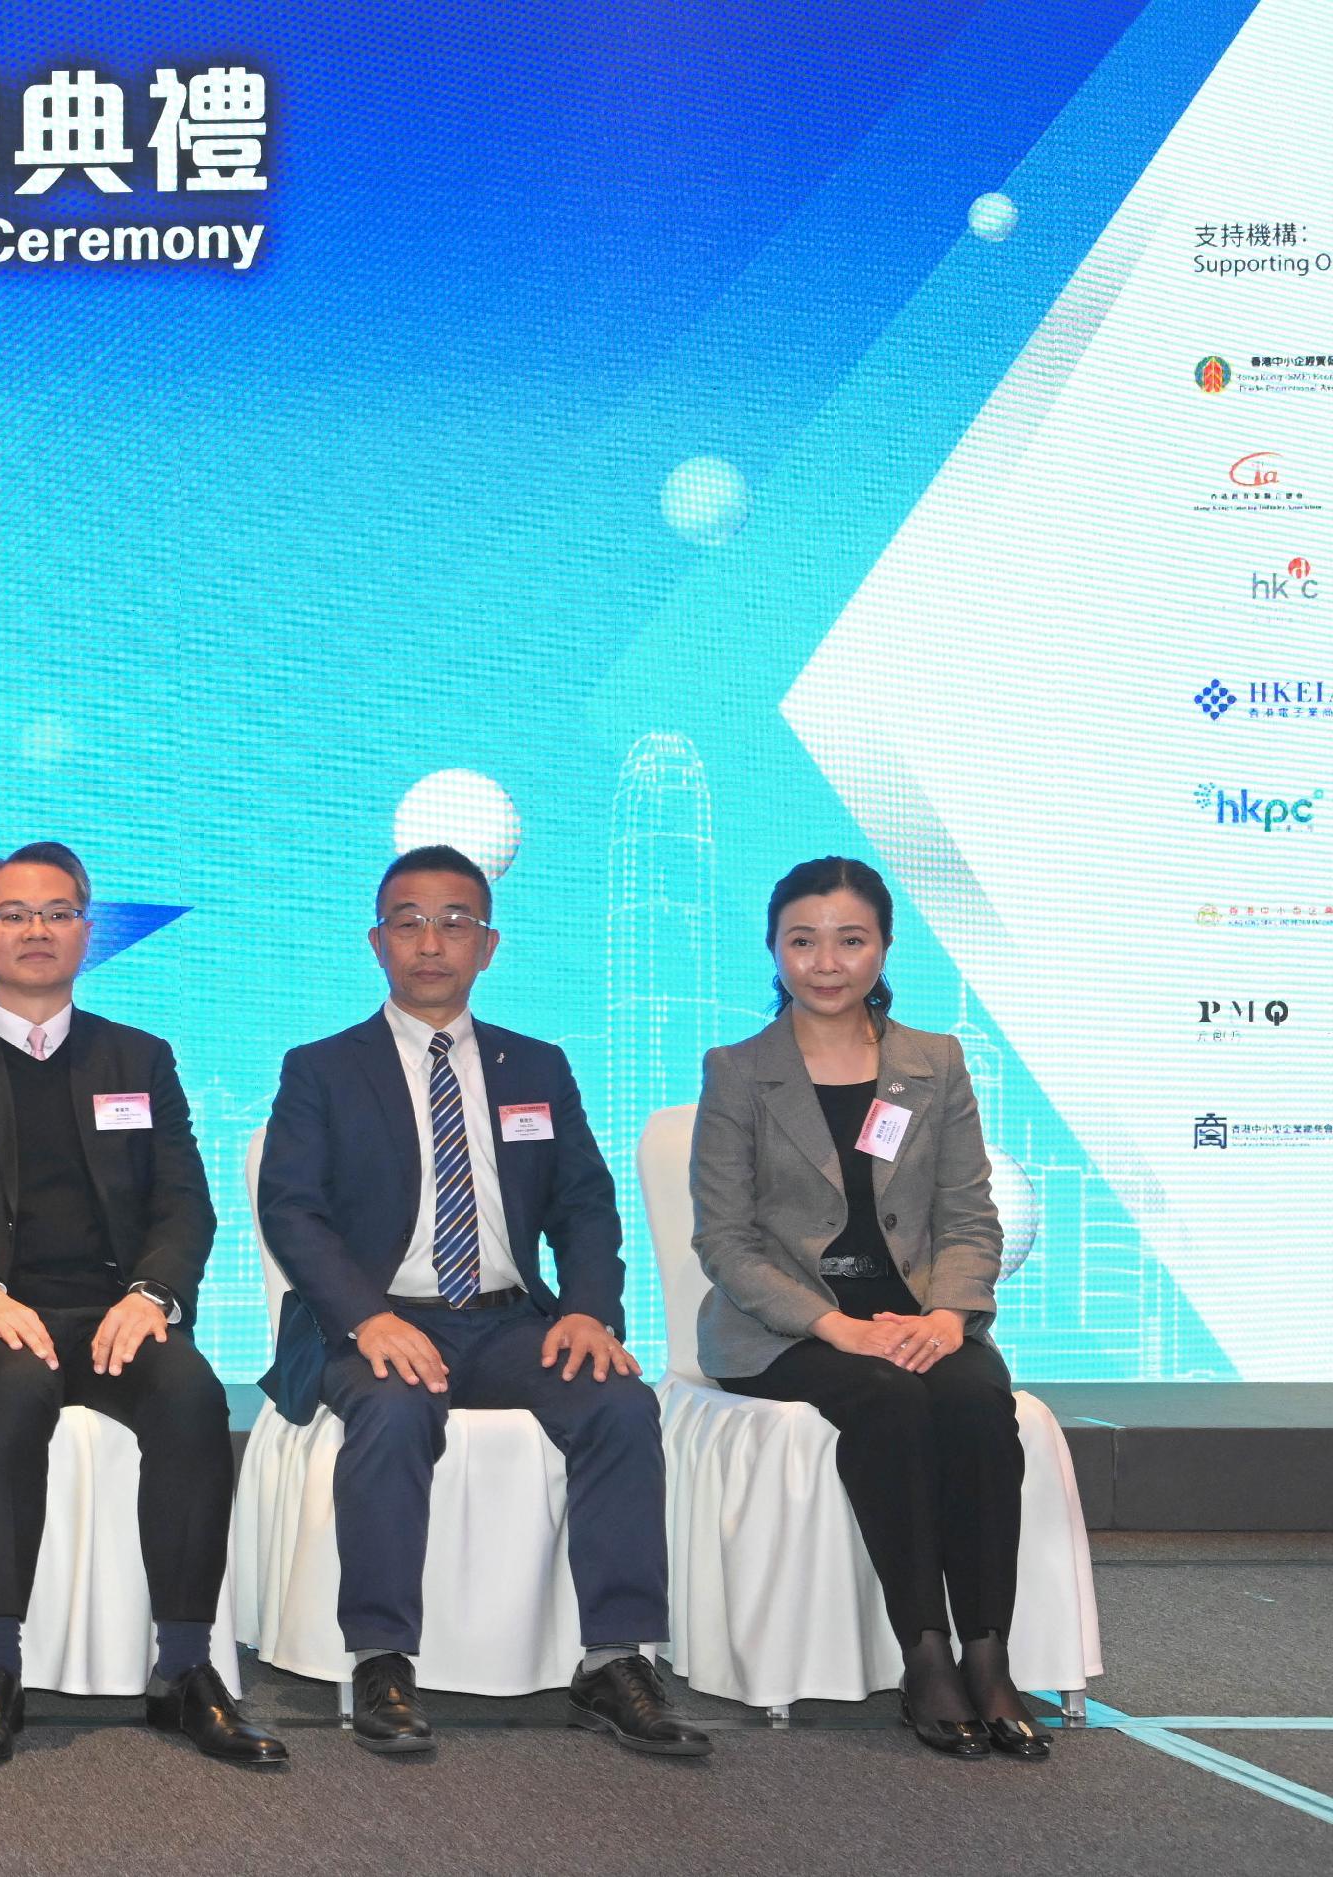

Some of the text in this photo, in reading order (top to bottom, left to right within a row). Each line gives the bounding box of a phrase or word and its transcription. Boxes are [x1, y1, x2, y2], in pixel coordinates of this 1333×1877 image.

[1193, 254, 1309, 277] Supporting
[1249, 681, 1333, 703] HKEI
[1217, 788, 1314, 833] hkpc
